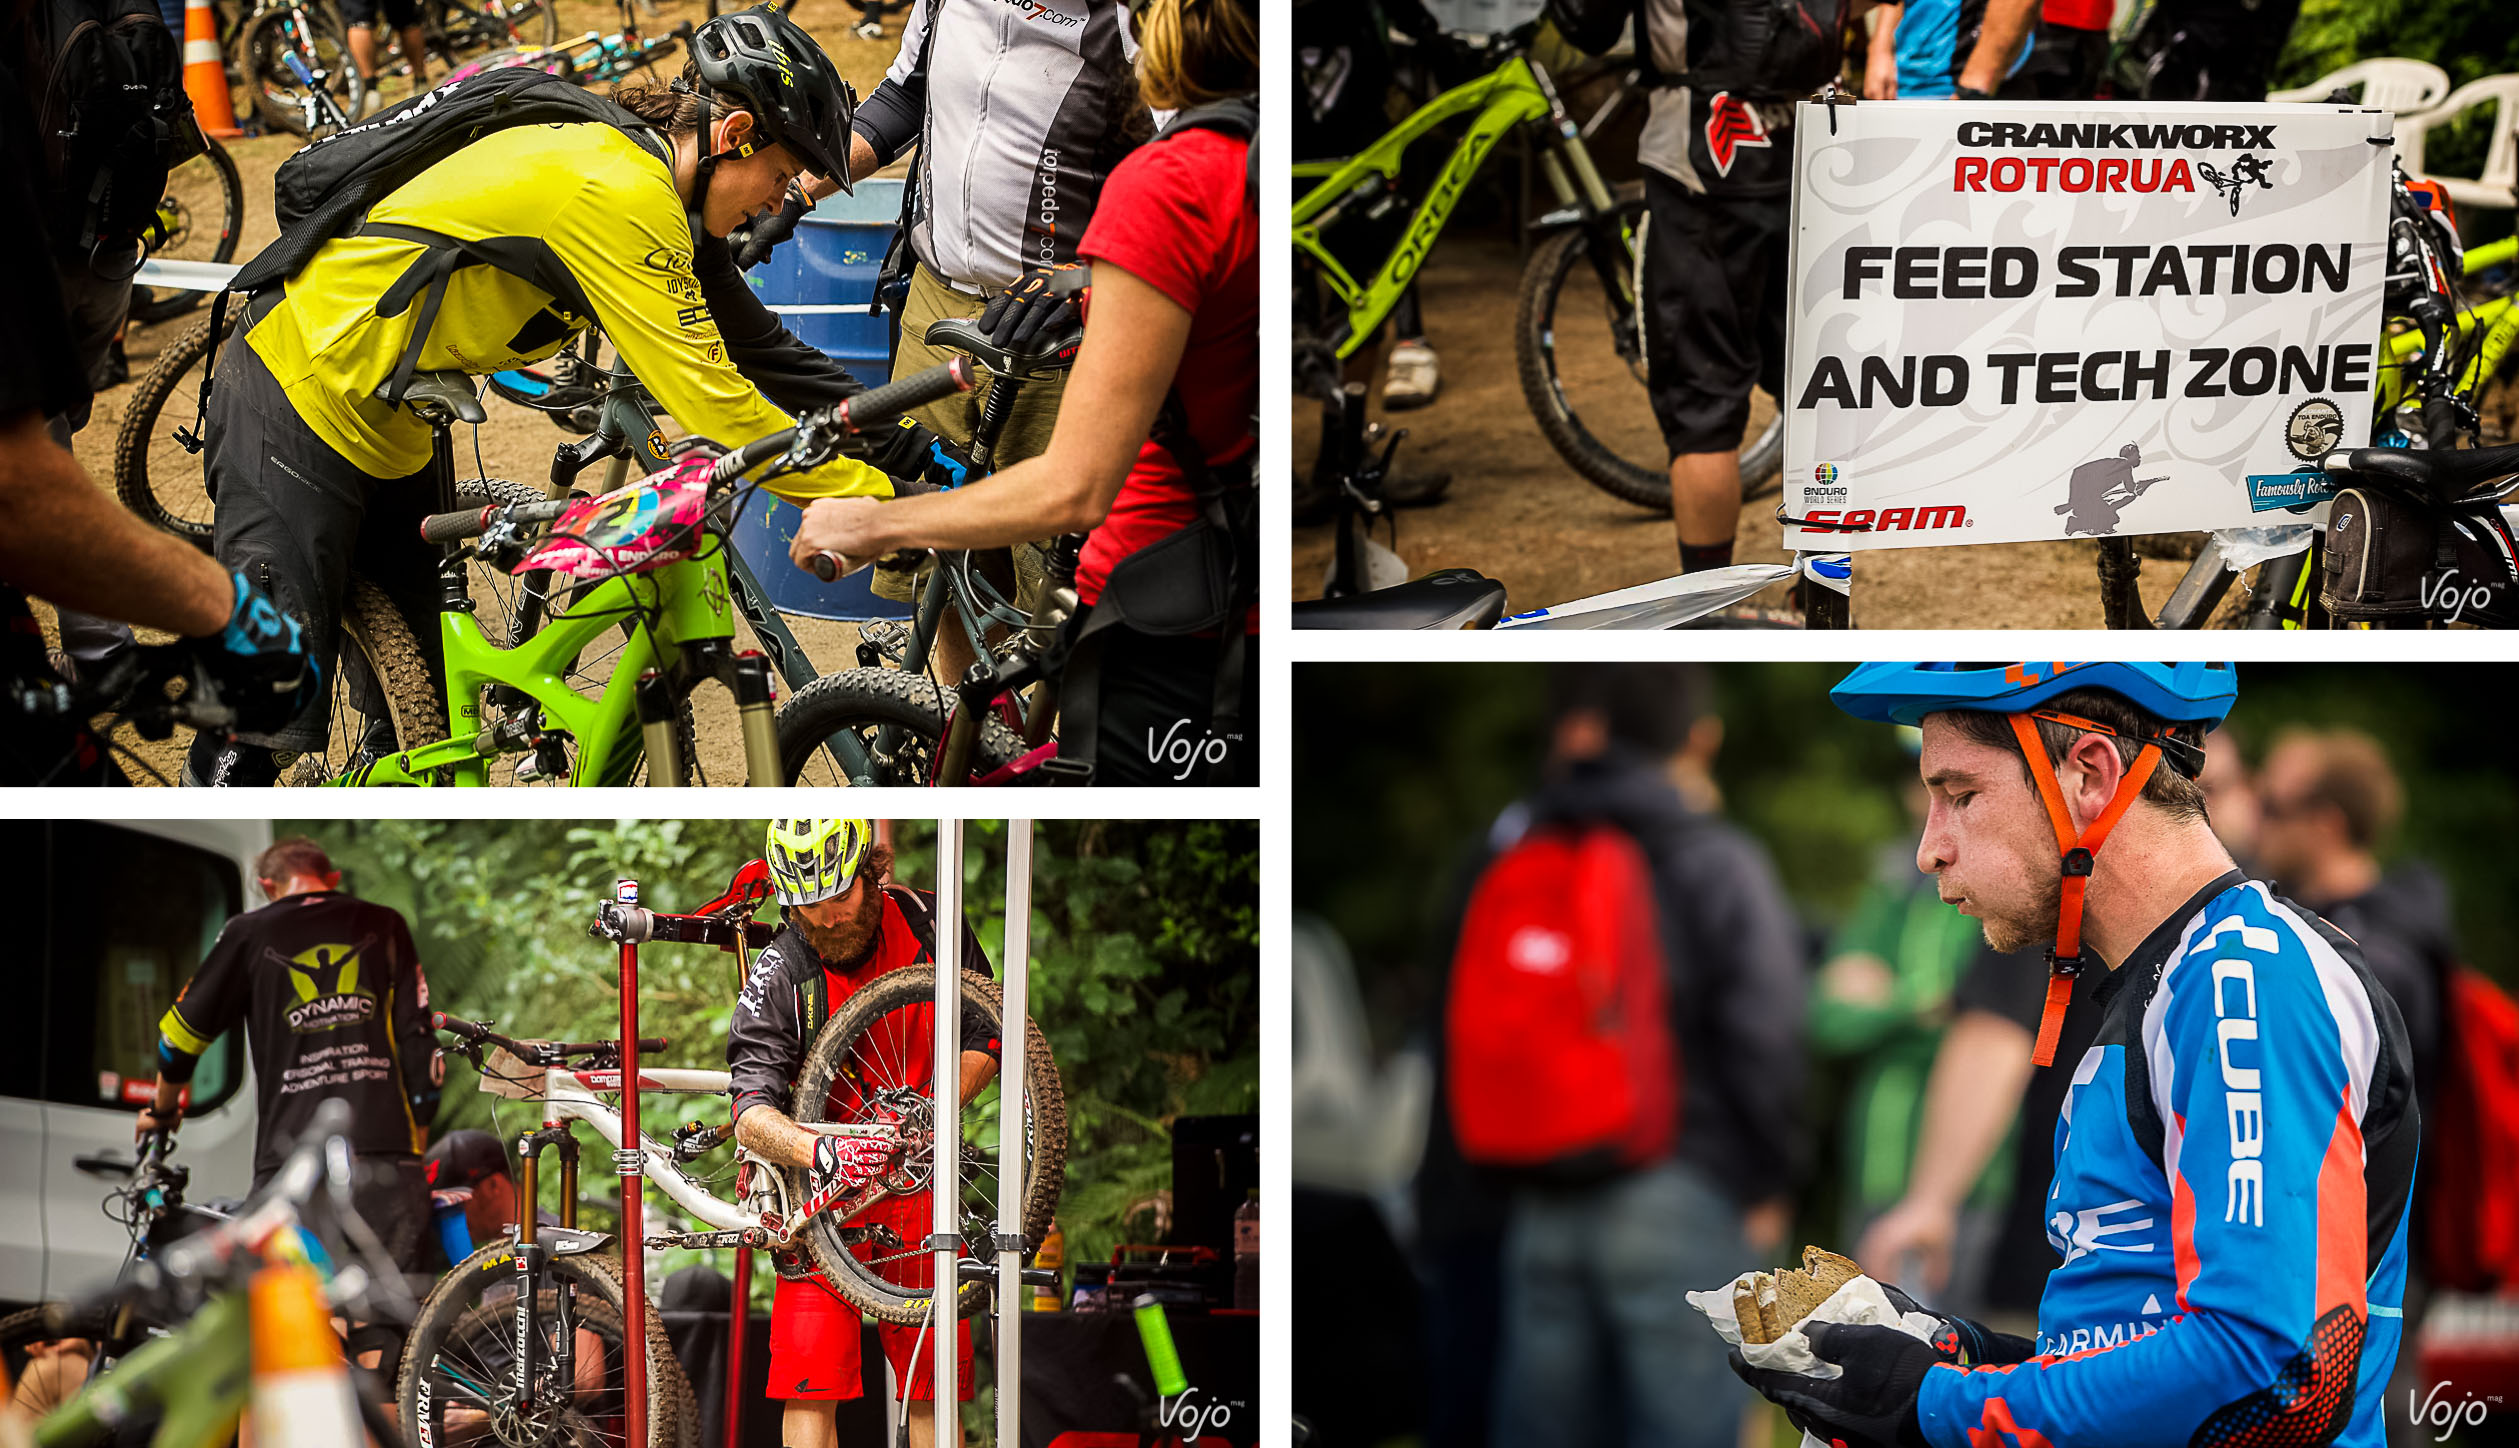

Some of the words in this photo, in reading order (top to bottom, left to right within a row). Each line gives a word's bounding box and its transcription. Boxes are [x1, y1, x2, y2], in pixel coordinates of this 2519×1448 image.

[768, 39, 794, 88] ibis
[1957, 121, 2277, 150] CRANKWORX
[1953, 156, 2196, 194] ROTORUA
[1843, 246, 2038, 300] FEED
[2055, 243, 2352, 298] STATION
[1797, 355, 1969, 410] AND
[1987, 349, 2172, 404] TECH
[2184, 343, 2372, 399] ZONE
[1803, 496, 1825, 504] WORLD
[1827, 496, 1847, 504] SERIES
[2256, 478, 2305, 500] Famously
[1800, 505, 1967, 534] SRAM
[289, 995, 373, 1027] DYNAMIC
[300, 1043, 369, 1064] INSPIRATION
[280, 1073, 349, 1094] ADVENTURE
[352, 1069, 389, 1081] SPORT
[283, 1060, 336, 1081] ERSONAL
[341, 1057, 391, 1069] TRAINING
[2211, 959, 2264, 1228] CUBE
[516, 1306, 526, 1388] marzocchi
